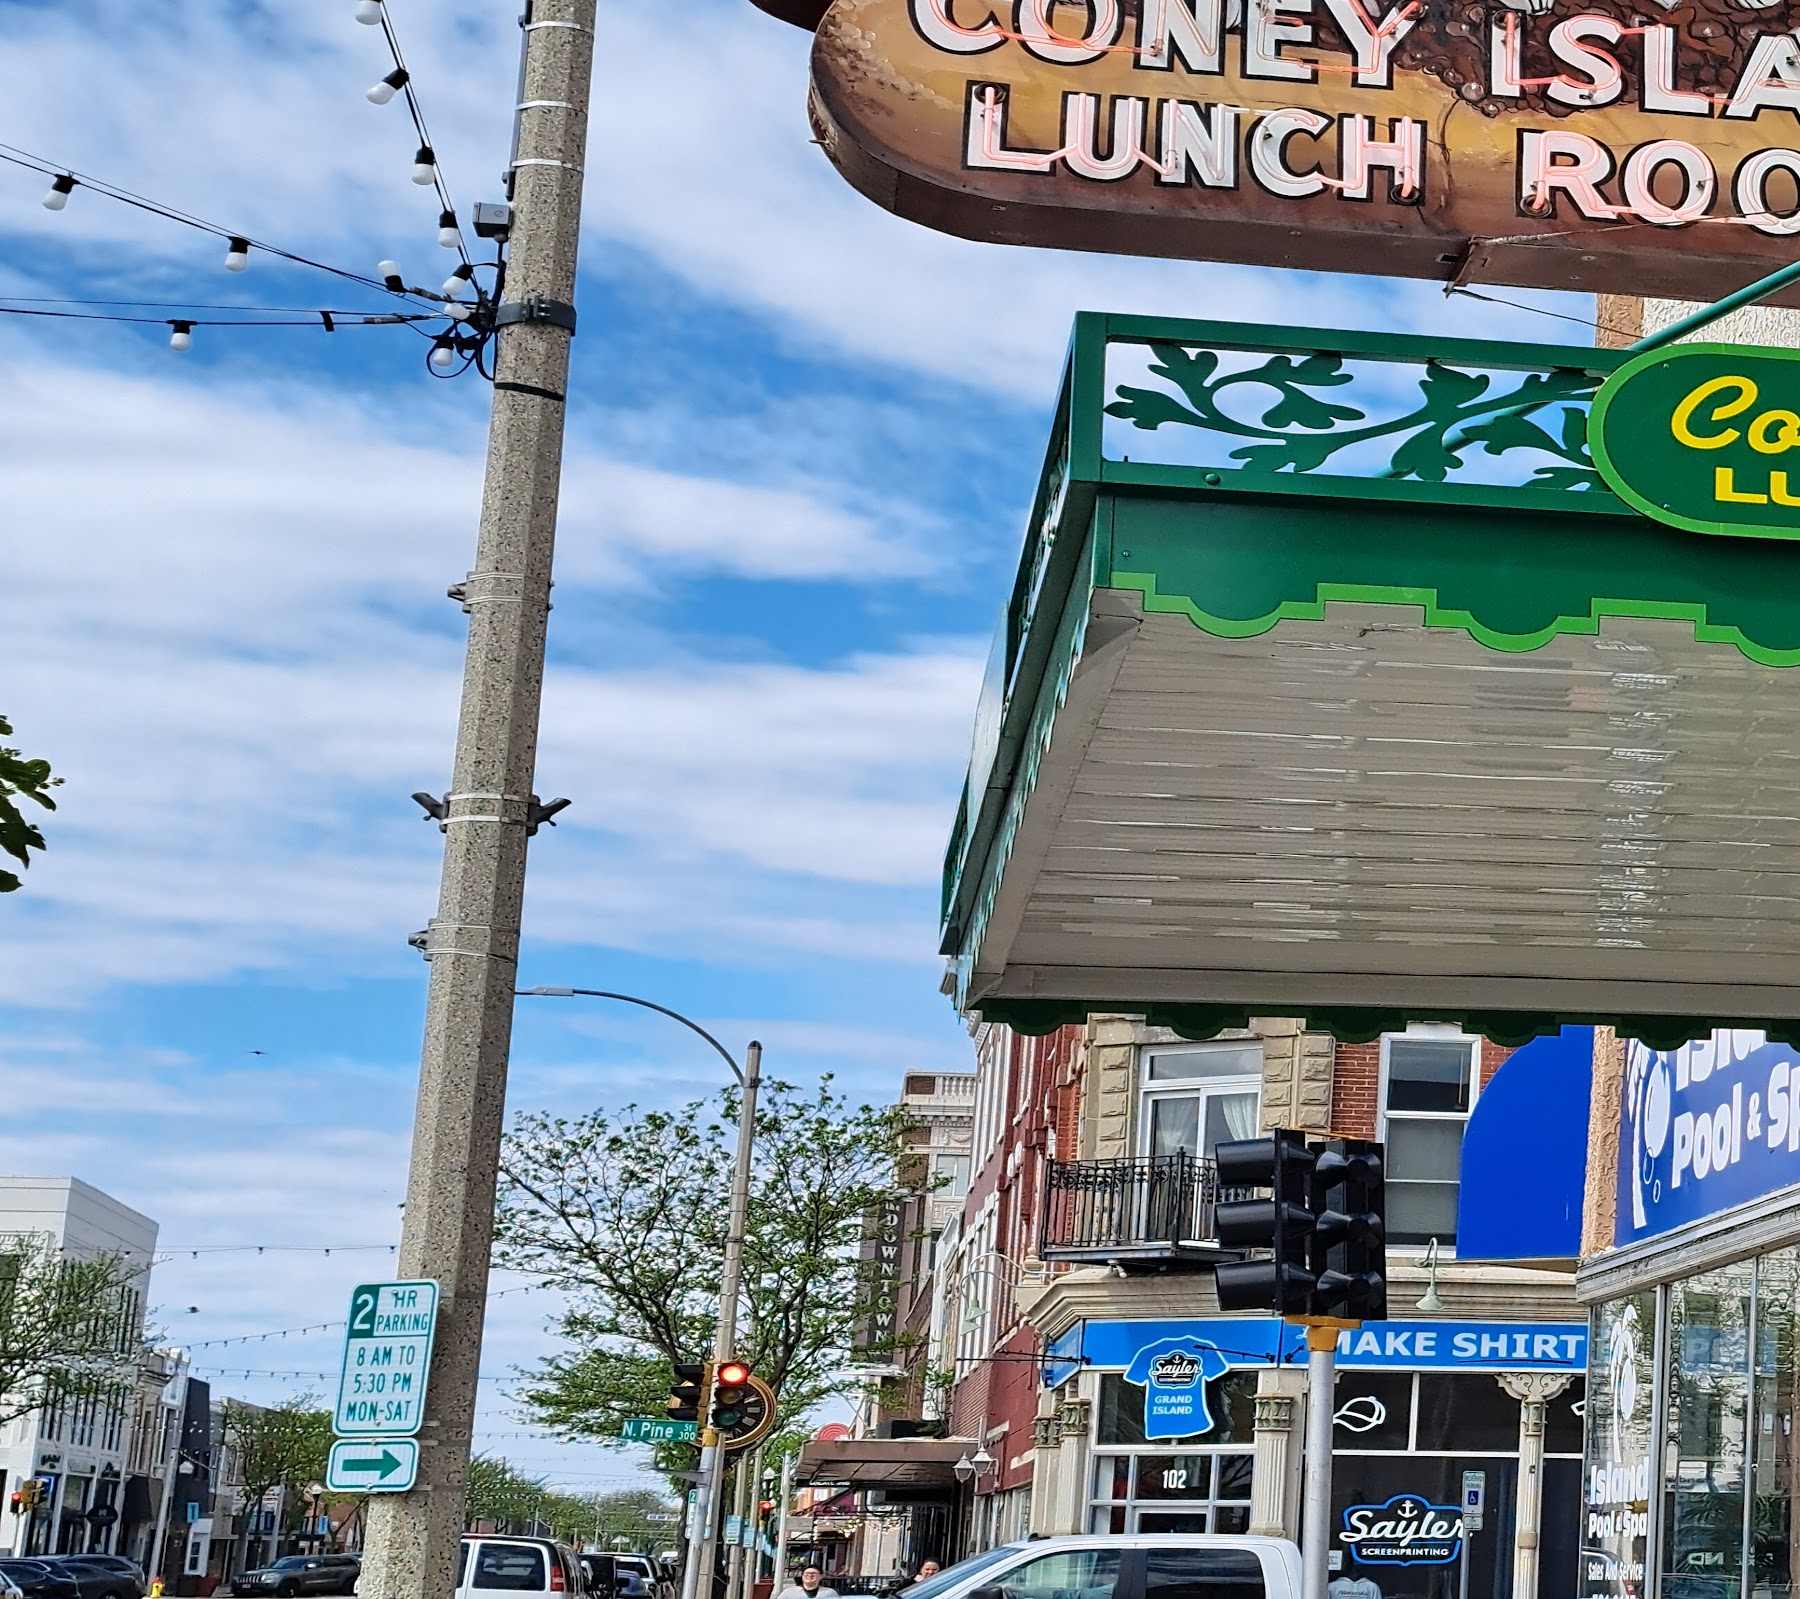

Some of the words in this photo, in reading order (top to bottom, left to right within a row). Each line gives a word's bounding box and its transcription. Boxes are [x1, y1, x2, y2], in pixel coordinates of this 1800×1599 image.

[964, 82, 1426, 204] LUNCH
[1671, 1082, 1742, 1189] Pool
[1747, 1092, 1761, 1140] &
[353, 1293, 374, 1330] 2
[394, 1290, 418, 1308] HR
[376, 1313, 428, 1332] PARKING
[357, 1347, 365, 1367] 8
[370, 1346, 391, 1366] AM
[398, 1345, 415, 1366] TO
[1452, 1332, 1585, 1359] SHIRT
[1151, 1360, 1202, 1377] Sayler
[353, 1373, 386, 1393] 5:30
[392, 1373, 412, 1392] PM
[1155, 1395, 1192, 1404] GRAND
[345, 1400, 412, 1421] MON-SAT
[1152, 1406, 1192, 1415] ISLAND
[622, 1421, 636, 1437] N.
[640, 1422, 674, 1438] Pine
[684, 1423, 692, 1432] St
[678, 1432, 696, 1440] 300
[1163, 1469, 1187, 1489] 102
[1590, 1462, 1649, 1505] Island
[1339, 1510, 1473, 1547] Sayler
[1588, 1512, 1614, 1539] Pool
[1622, 1510, 1648, 1542] Spa
[1361, 1548, 1449, 1556] SCREENPRINTING
[1588, 1561, 1604, 1582] Sales
[1605, 1561, 1618, 1581] And
[1619, 1558, 1643, 1582] Service
